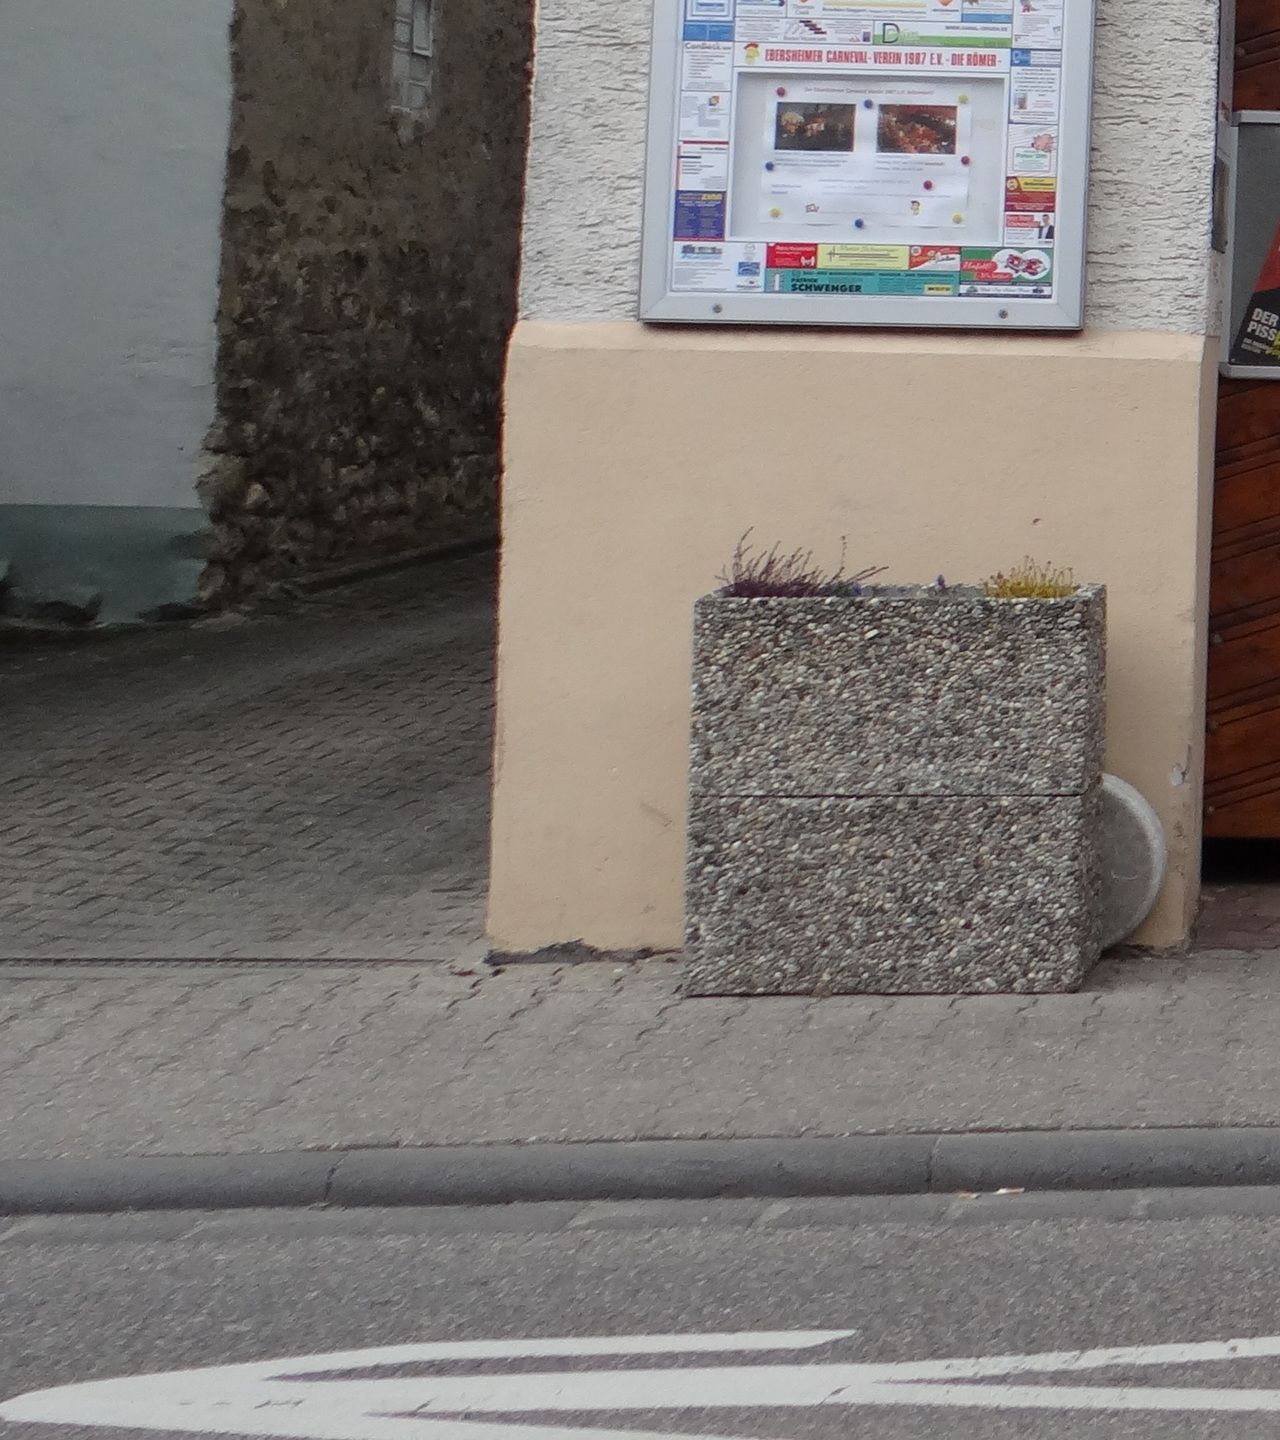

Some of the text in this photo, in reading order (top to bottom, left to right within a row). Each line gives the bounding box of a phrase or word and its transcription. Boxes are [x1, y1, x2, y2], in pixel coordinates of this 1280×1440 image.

[765, 48, 823, 64] EBERSHEIMER
[873, 51, 902, 65] VEREIN
[951, 53, 964, 66] DIE
[966, 52, 996, 67] RÖMER
[791, 282, 862, 293] SCHWENGER
[1251, 307, 1280, 328] DER
